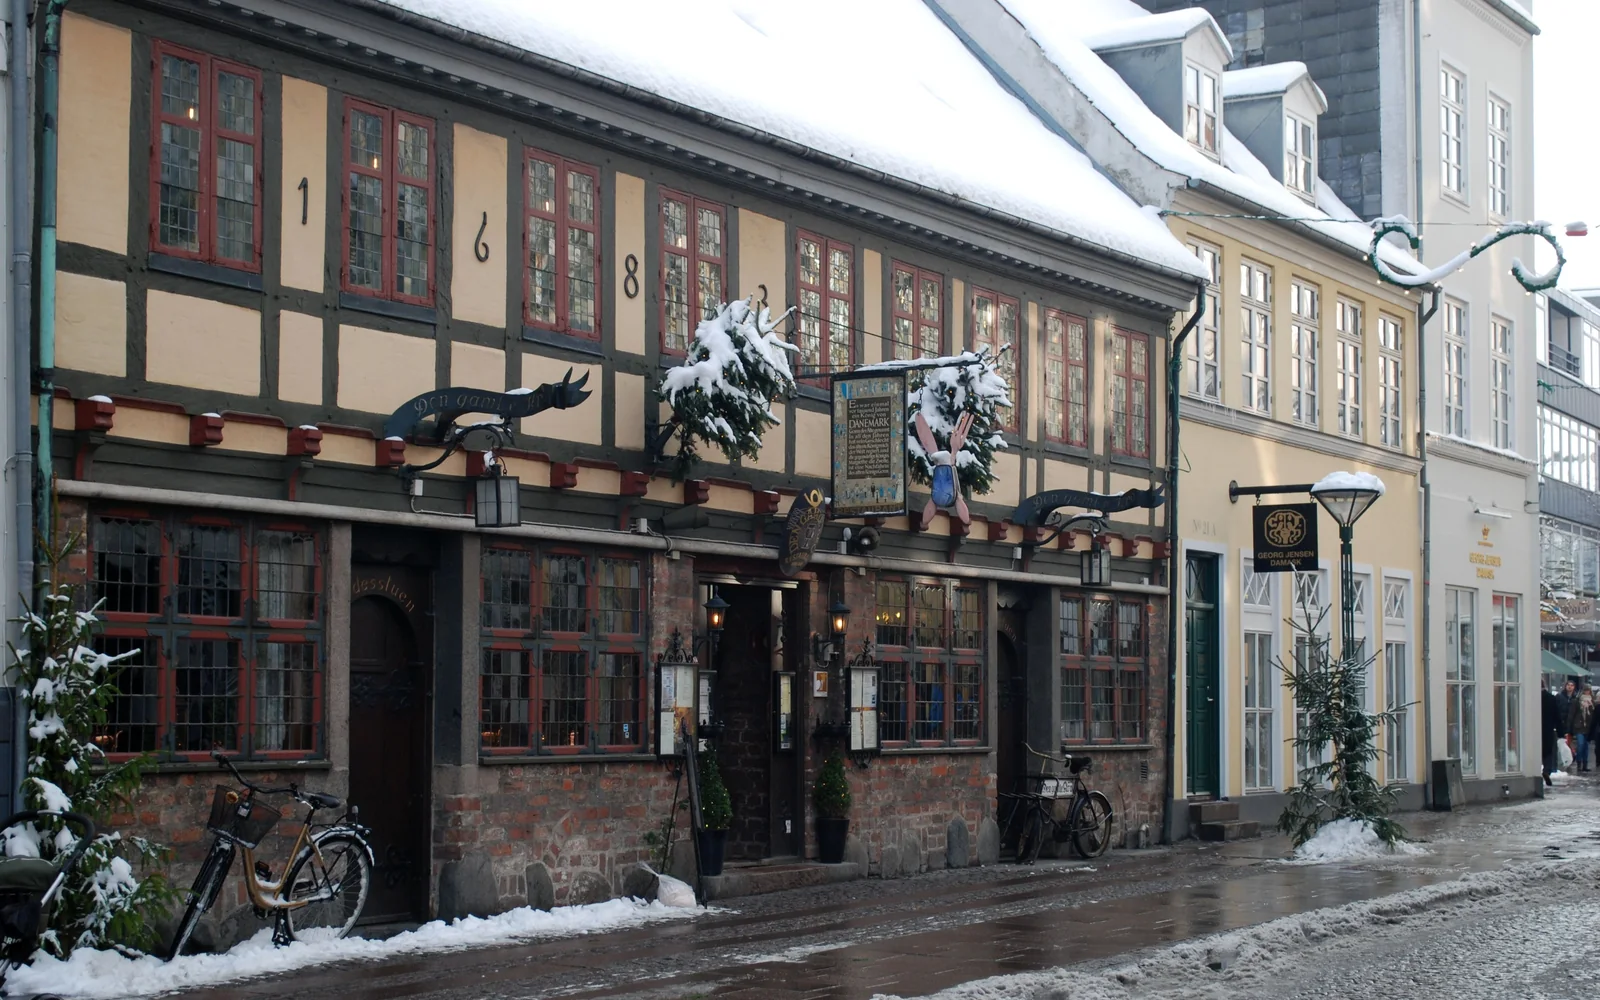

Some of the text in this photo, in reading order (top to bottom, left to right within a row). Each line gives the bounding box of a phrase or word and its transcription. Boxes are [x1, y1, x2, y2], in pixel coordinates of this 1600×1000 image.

[297, 176, 309, 225] 1
[474, 211, 490, 263] 6
[623, 253, 639, 299] 8
[1285, 550, 1314, 558] JENSEN
[1270, 559, 1302, 567] DAMASK
